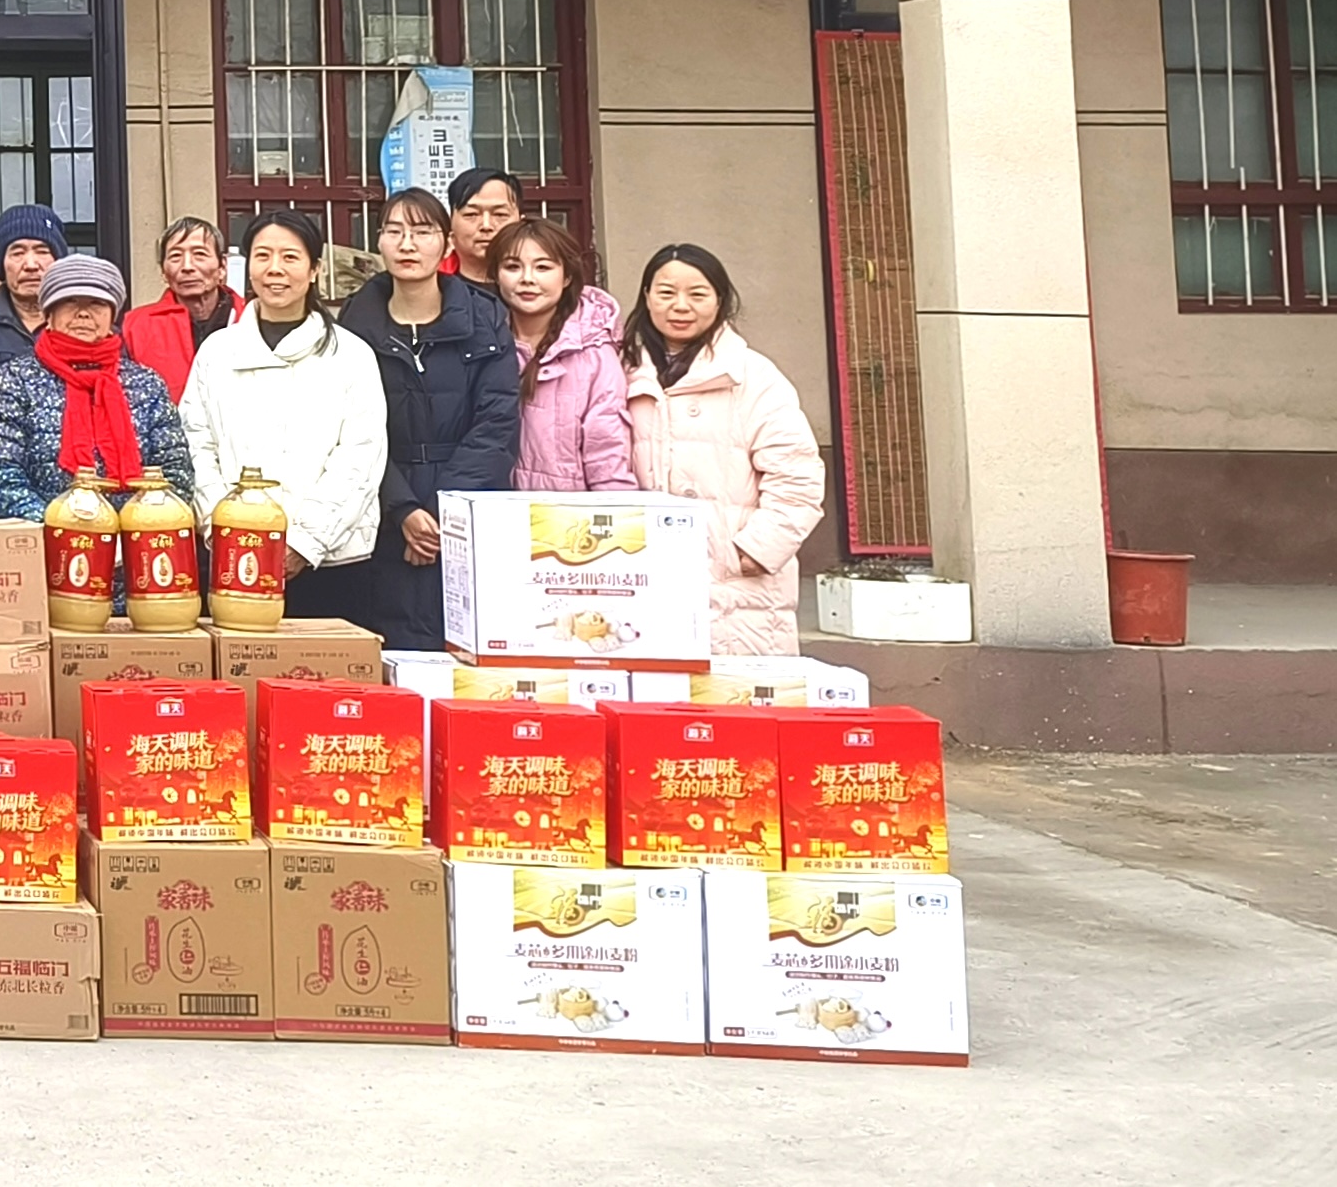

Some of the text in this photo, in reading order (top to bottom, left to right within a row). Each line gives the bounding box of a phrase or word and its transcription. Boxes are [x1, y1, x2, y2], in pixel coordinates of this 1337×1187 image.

[128, 729, 216, 756] 海天调味
[301, 729, 393, 756] 海天调味
[130, 749, 216, 775] 家的味道
[303, 751, 393, 776] 家的味道
[480, 755, 572, 780] 海天调味
[650, 757, 743, 783] 海天调味
[483, 774, 574, 798] 家的味道
[811, 762, 907, 788] 海天调味
[653, 777, 746, 801] 家的味道
[815, 782, 910, 806] 家的味道
[157, 886, 214, 911] 家香味
[330, 888, 389, 913] 家香味
[0, 979, 65, 995] 东北长粒香
